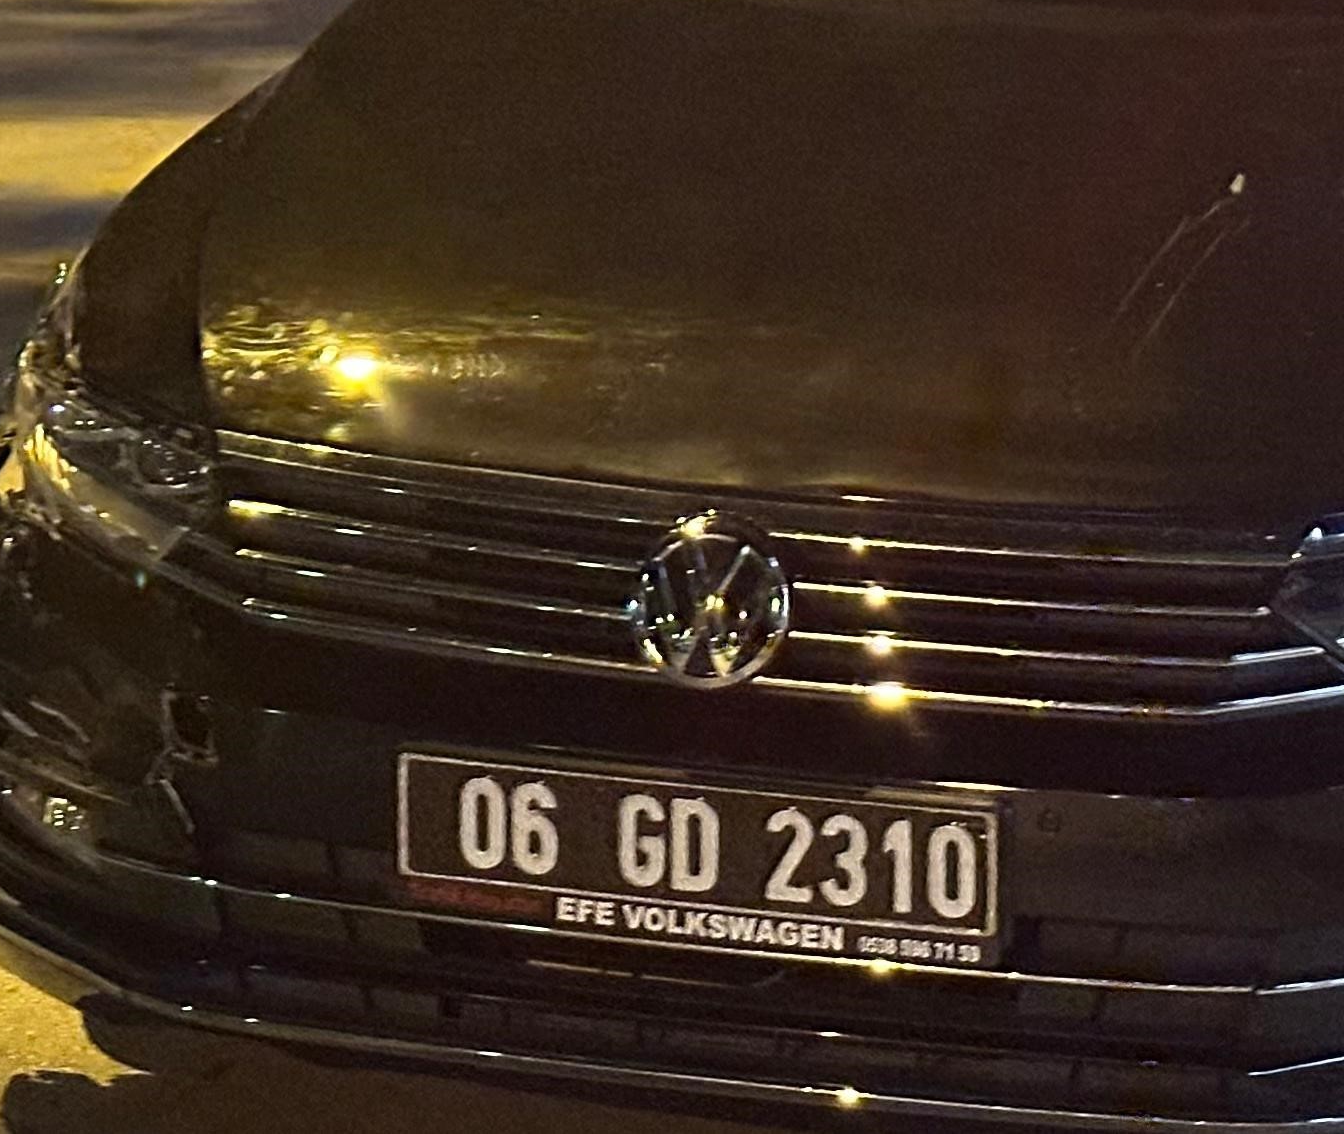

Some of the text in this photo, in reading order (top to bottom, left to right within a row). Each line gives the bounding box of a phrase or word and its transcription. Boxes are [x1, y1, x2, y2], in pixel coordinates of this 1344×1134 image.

[459, 774, 977, 919] 06 GD 2310
[556, 896, 616, 927] EFE
[621, 903, 845, 951] VOLKSWAGEN
